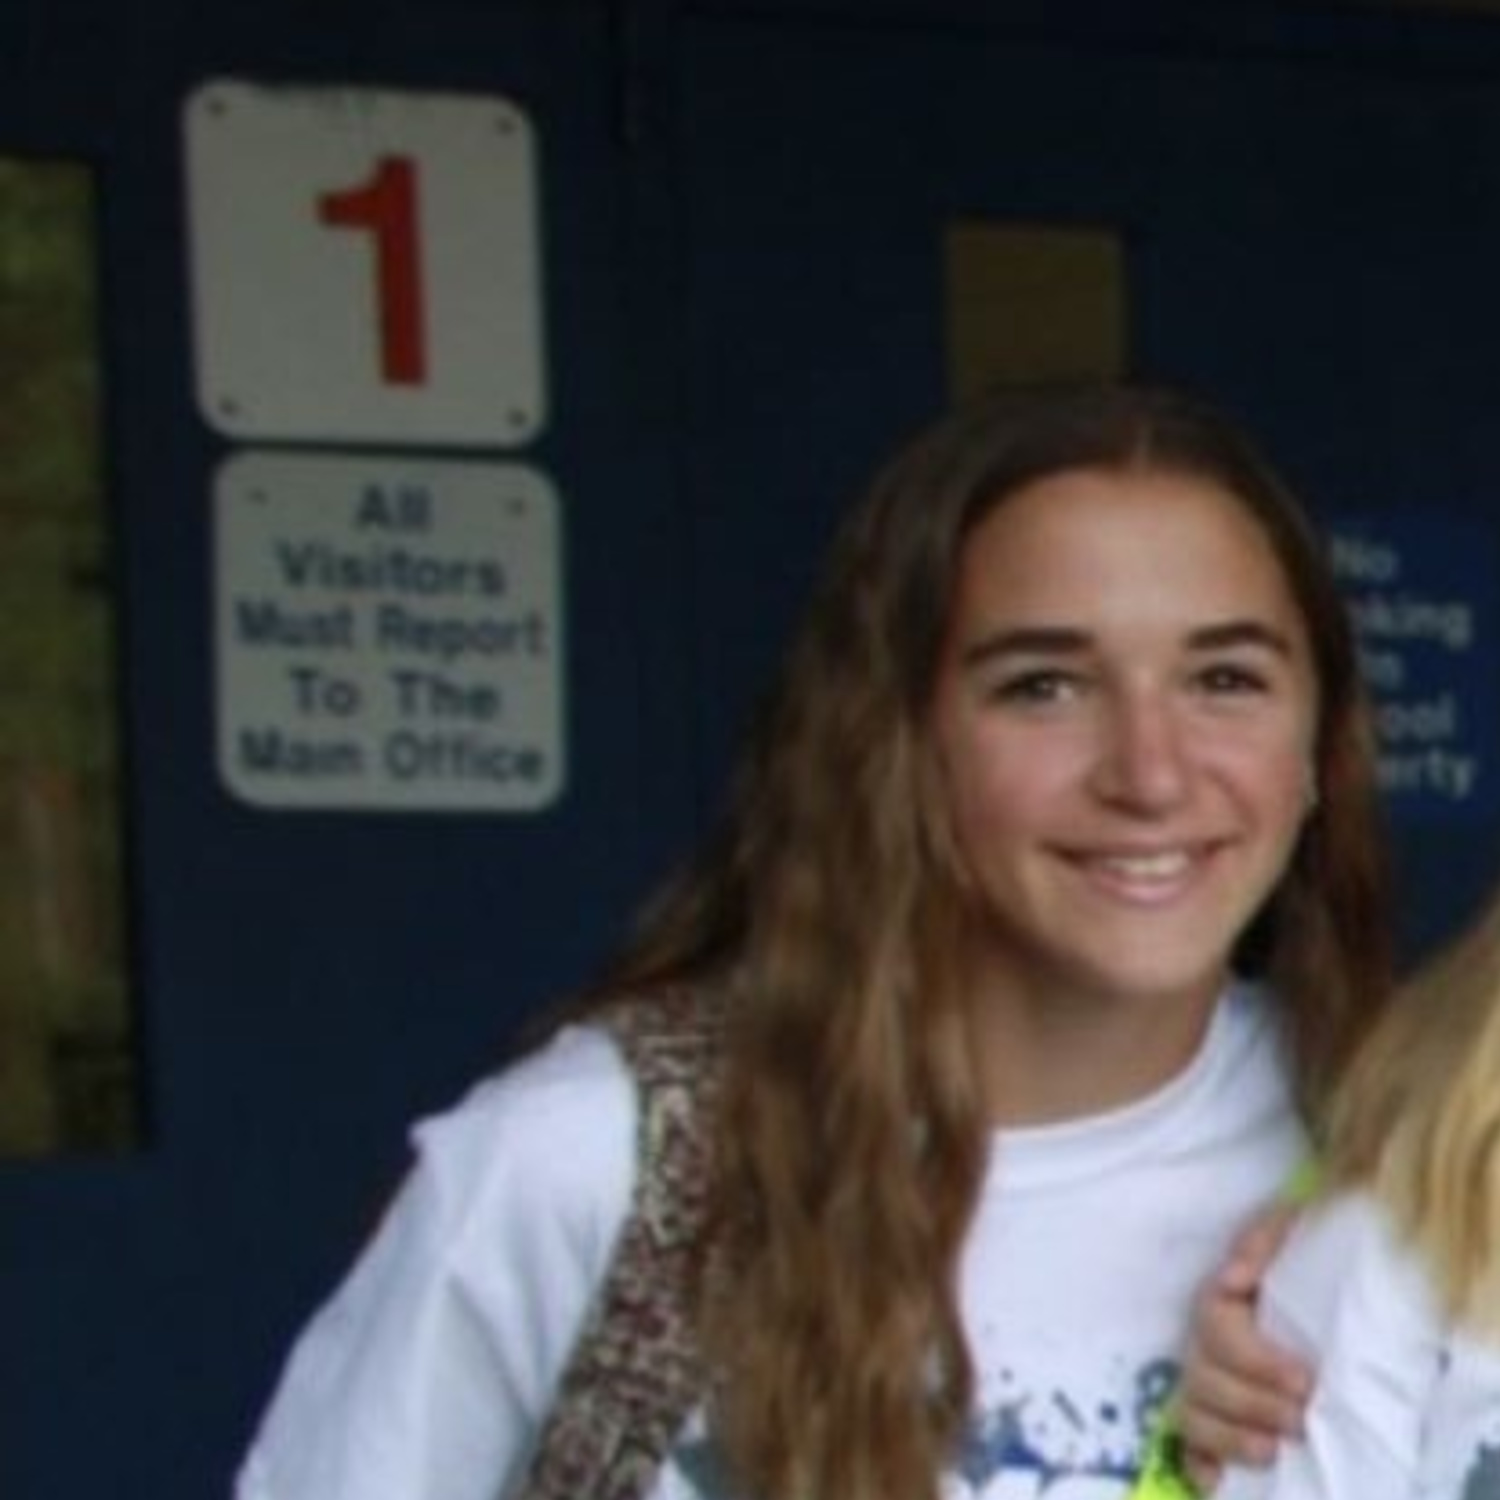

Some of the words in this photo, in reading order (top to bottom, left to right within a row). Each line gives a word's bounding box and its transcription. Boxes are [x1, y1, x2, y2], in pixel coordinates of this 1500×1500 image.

[316, 155, 428, 387] 1
[354, 485, 434, 532] All
[276, 540, 508, 595] Visitors
[236, 600, 354, 648] Must
[376, 604, 547, 662] Report
[290, 666, 362, 717] To
[392, 670, 500, 719] The
[238, 728, 364, 776] Main
[385, 732, 544, 782] Office
